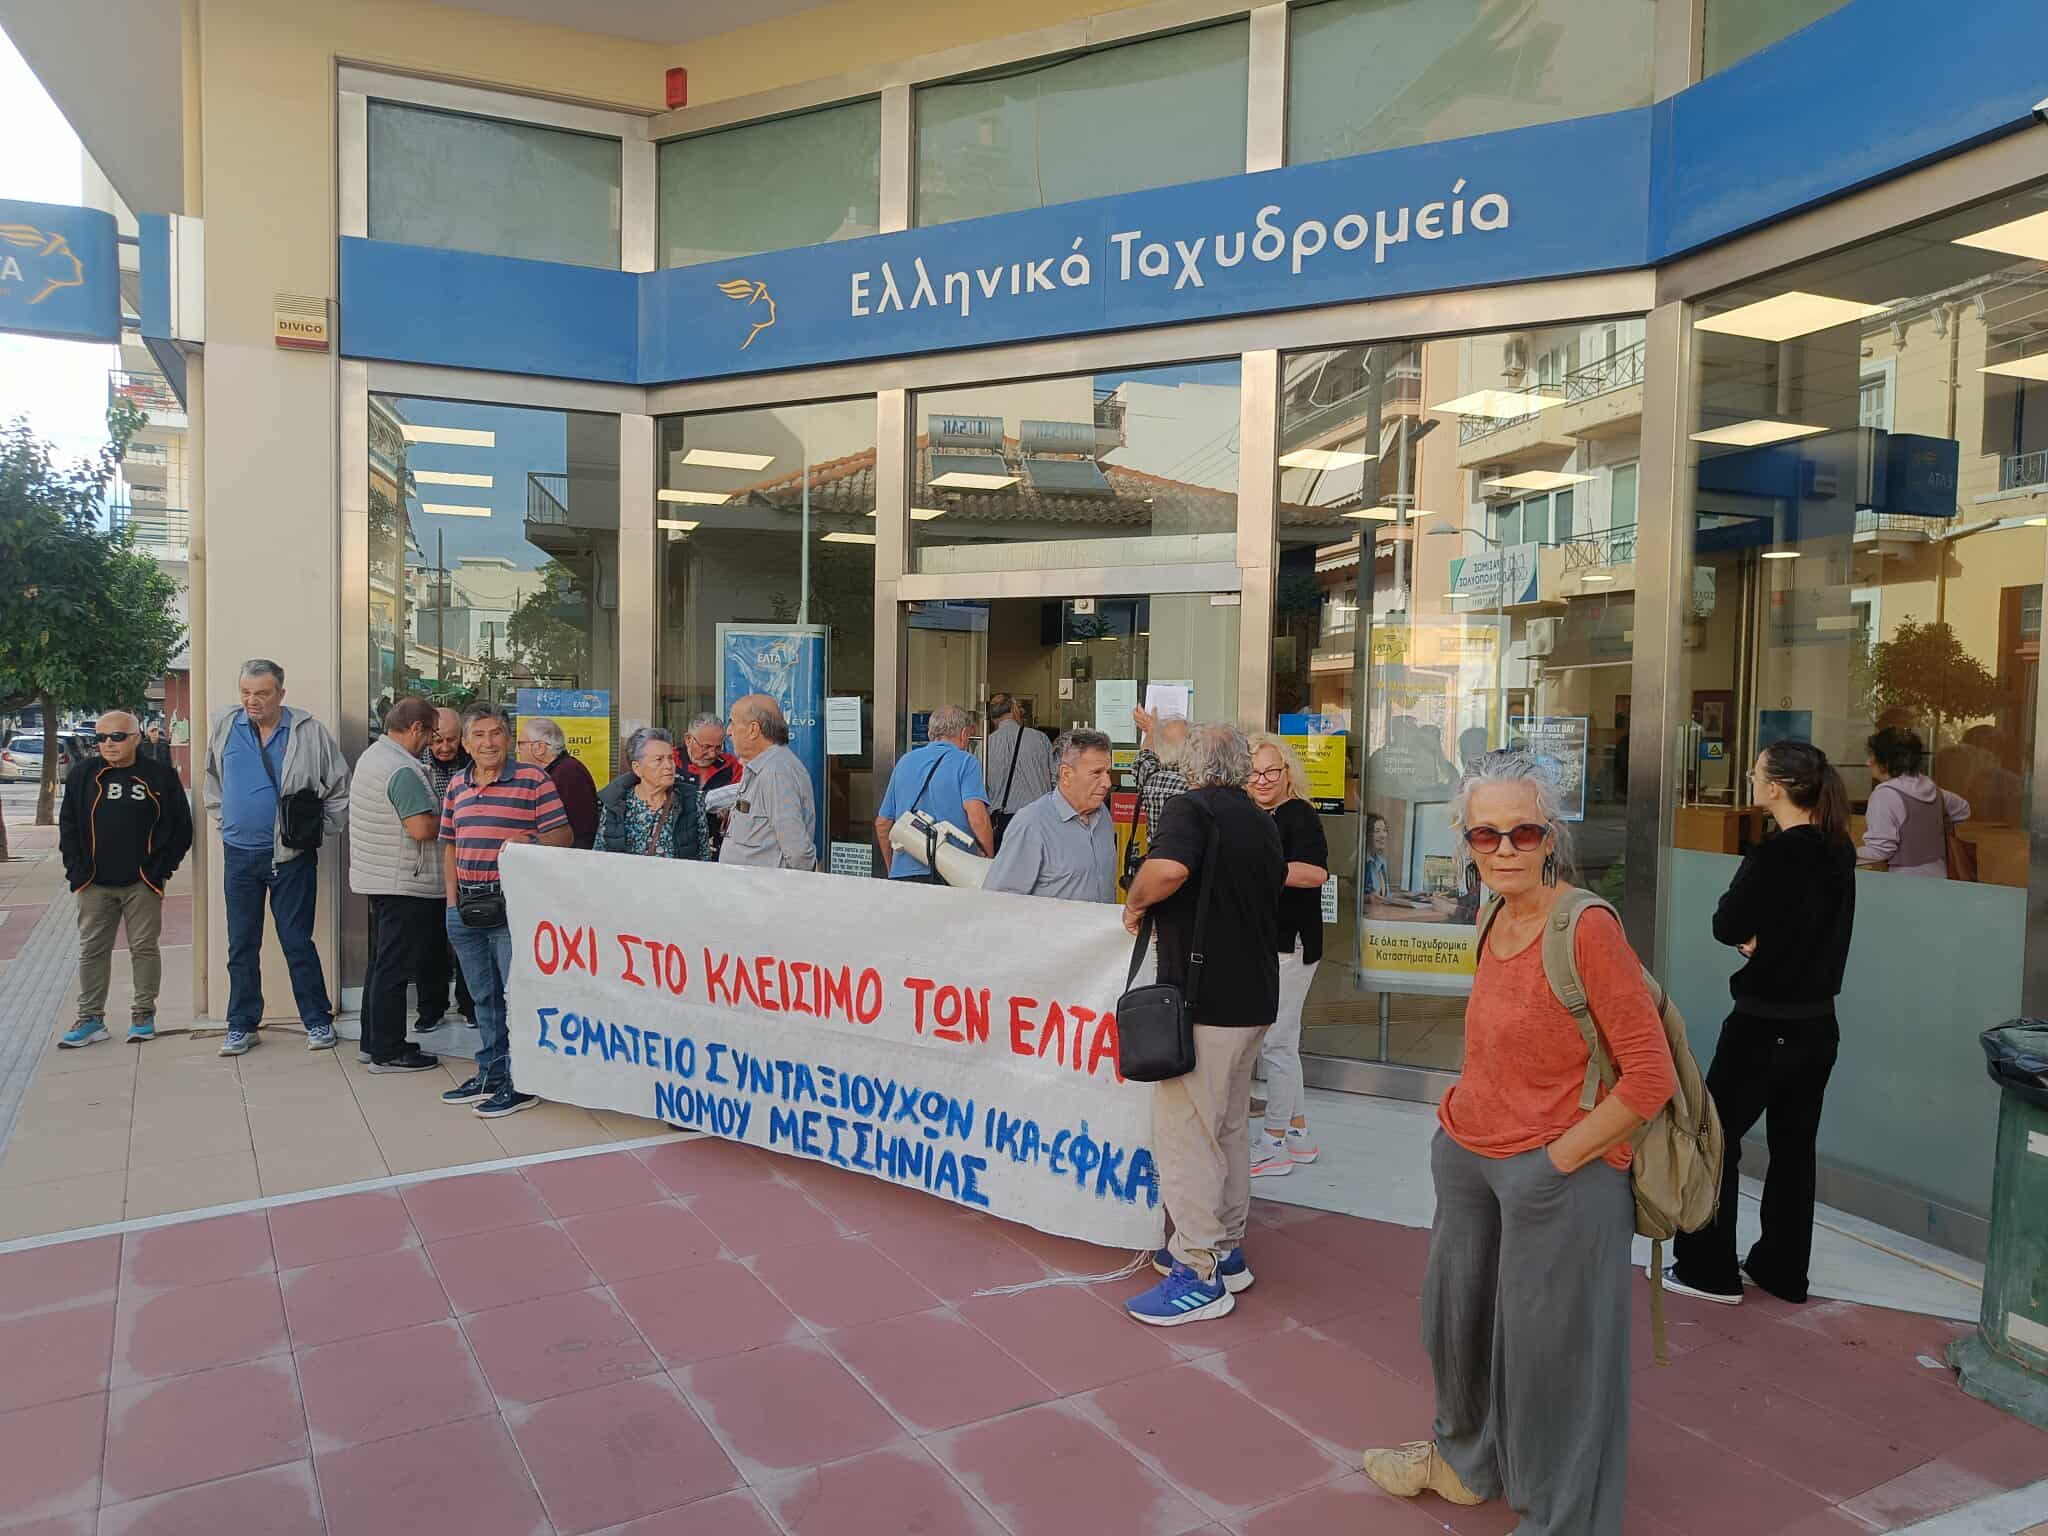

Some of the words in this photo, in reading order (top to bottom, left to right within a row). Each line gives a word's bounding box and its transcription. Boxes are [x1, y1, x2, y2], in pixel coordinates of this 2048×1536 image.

[851, 236, 1090, 317] Ελληνικά
[1111, 178, 1509, 290] Ταχυδρομεία
[279, 320, 322, 334] DIVICO
[758, 653, 781, 664] ΕΛΤΑ
[1544, 724, 1560, 733] POST
[1562, 724, 1576, 733] DAY
[567, 735, 592, 745] and
[1369, 934, 1379, 947] Σε
[1381, 935, 1398, 948] όλα
[1400, 938, 1409, 948] τα
[1411, 937, 1468, 952] Ταχυδρομικά
[1375, 949, 1433, 965] Καταστήματα
[1435, 952, 1459, 965] ΕΛΤΑ
[534, 920, 598, 977] ΟΧΙ
[617, 934, 688, 995] ΣΤΟ
[703, 946, 883, 1025] ΚΛΕΙΣΙΜΟ
[904, 977, 991, 1045] ΤΩΝ
[1008, 995, 1125, 1084] ΕΛΤΑ
[536, 1007, 696, 1079] ΣΩΜΑΤΕΙΟ
[705, 1042, 975, 1142] ΣΥΝΤΑΞΙΟΥΧΩΝ
[984, 1107, 1161, 1210] ΙΚΑ-ΕΦΚΑ
[654, 1081, 751, 1139] ΝΟΜΟΥ
[768, 1105, 990, 1207] ΜΕΣΣΗΝΙΑΣ
